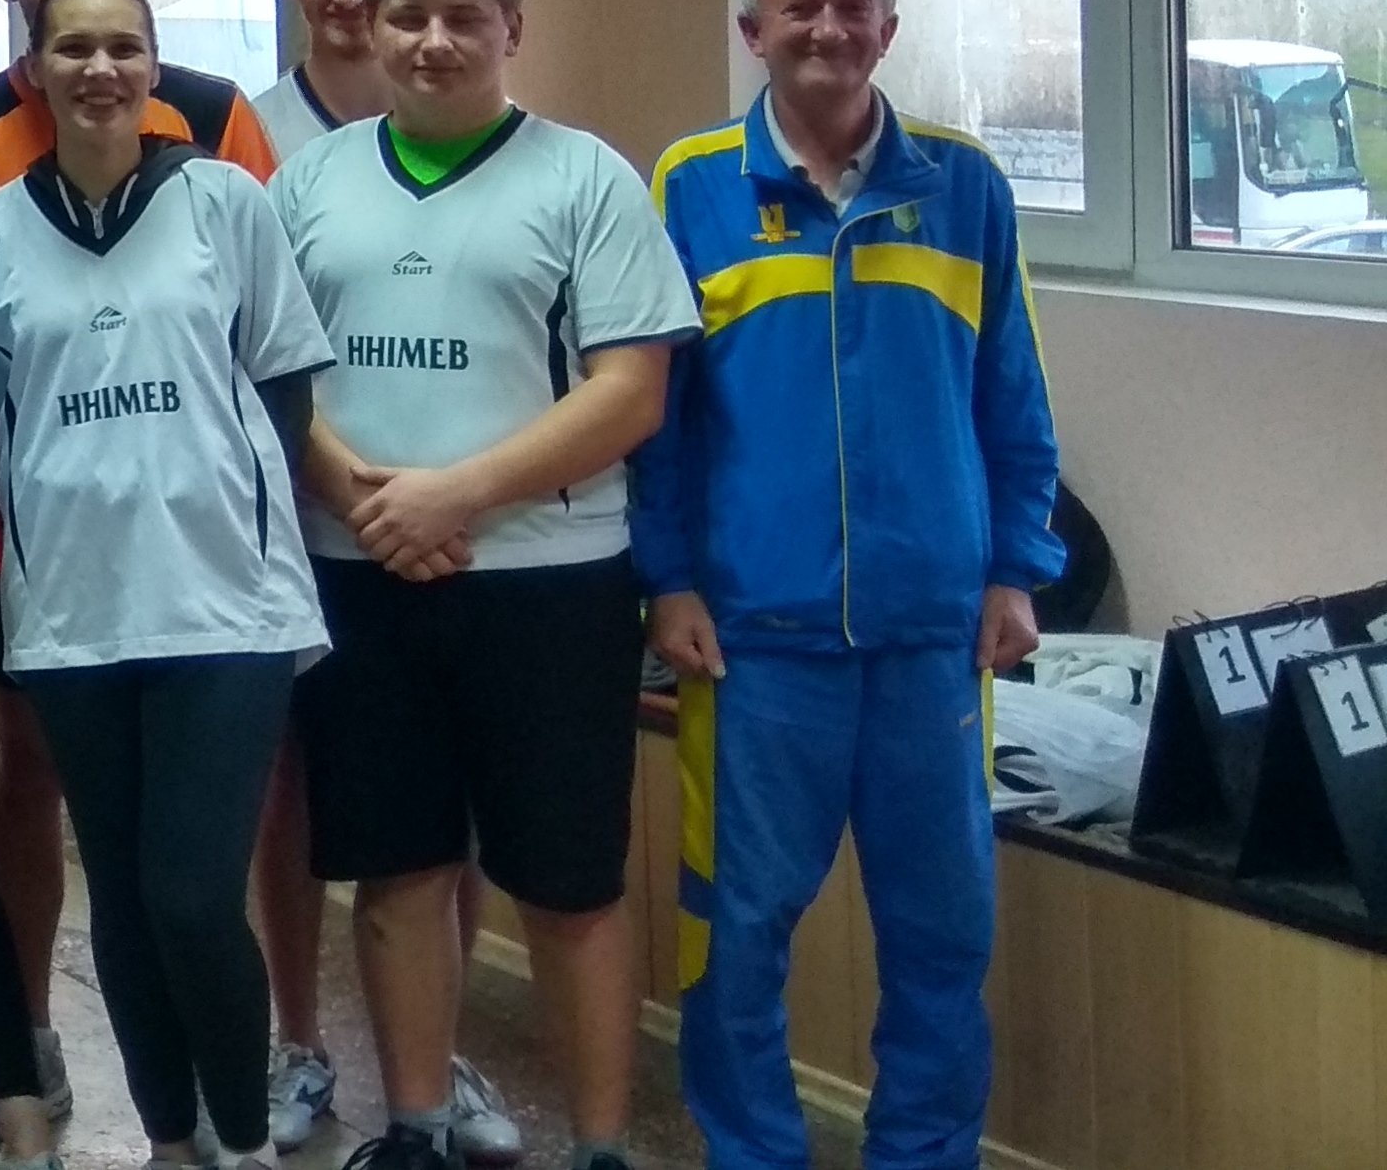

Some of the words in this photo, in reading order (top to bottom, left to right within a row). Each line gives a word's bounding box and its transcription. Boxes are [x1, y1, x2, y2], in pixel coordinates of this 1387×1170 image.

[391, 263, 433, 276] Start
[89, 317, 127, 333] Start
[1218, 646, 1247, 684] 1
[1341, 692, 1370, 731] 1
